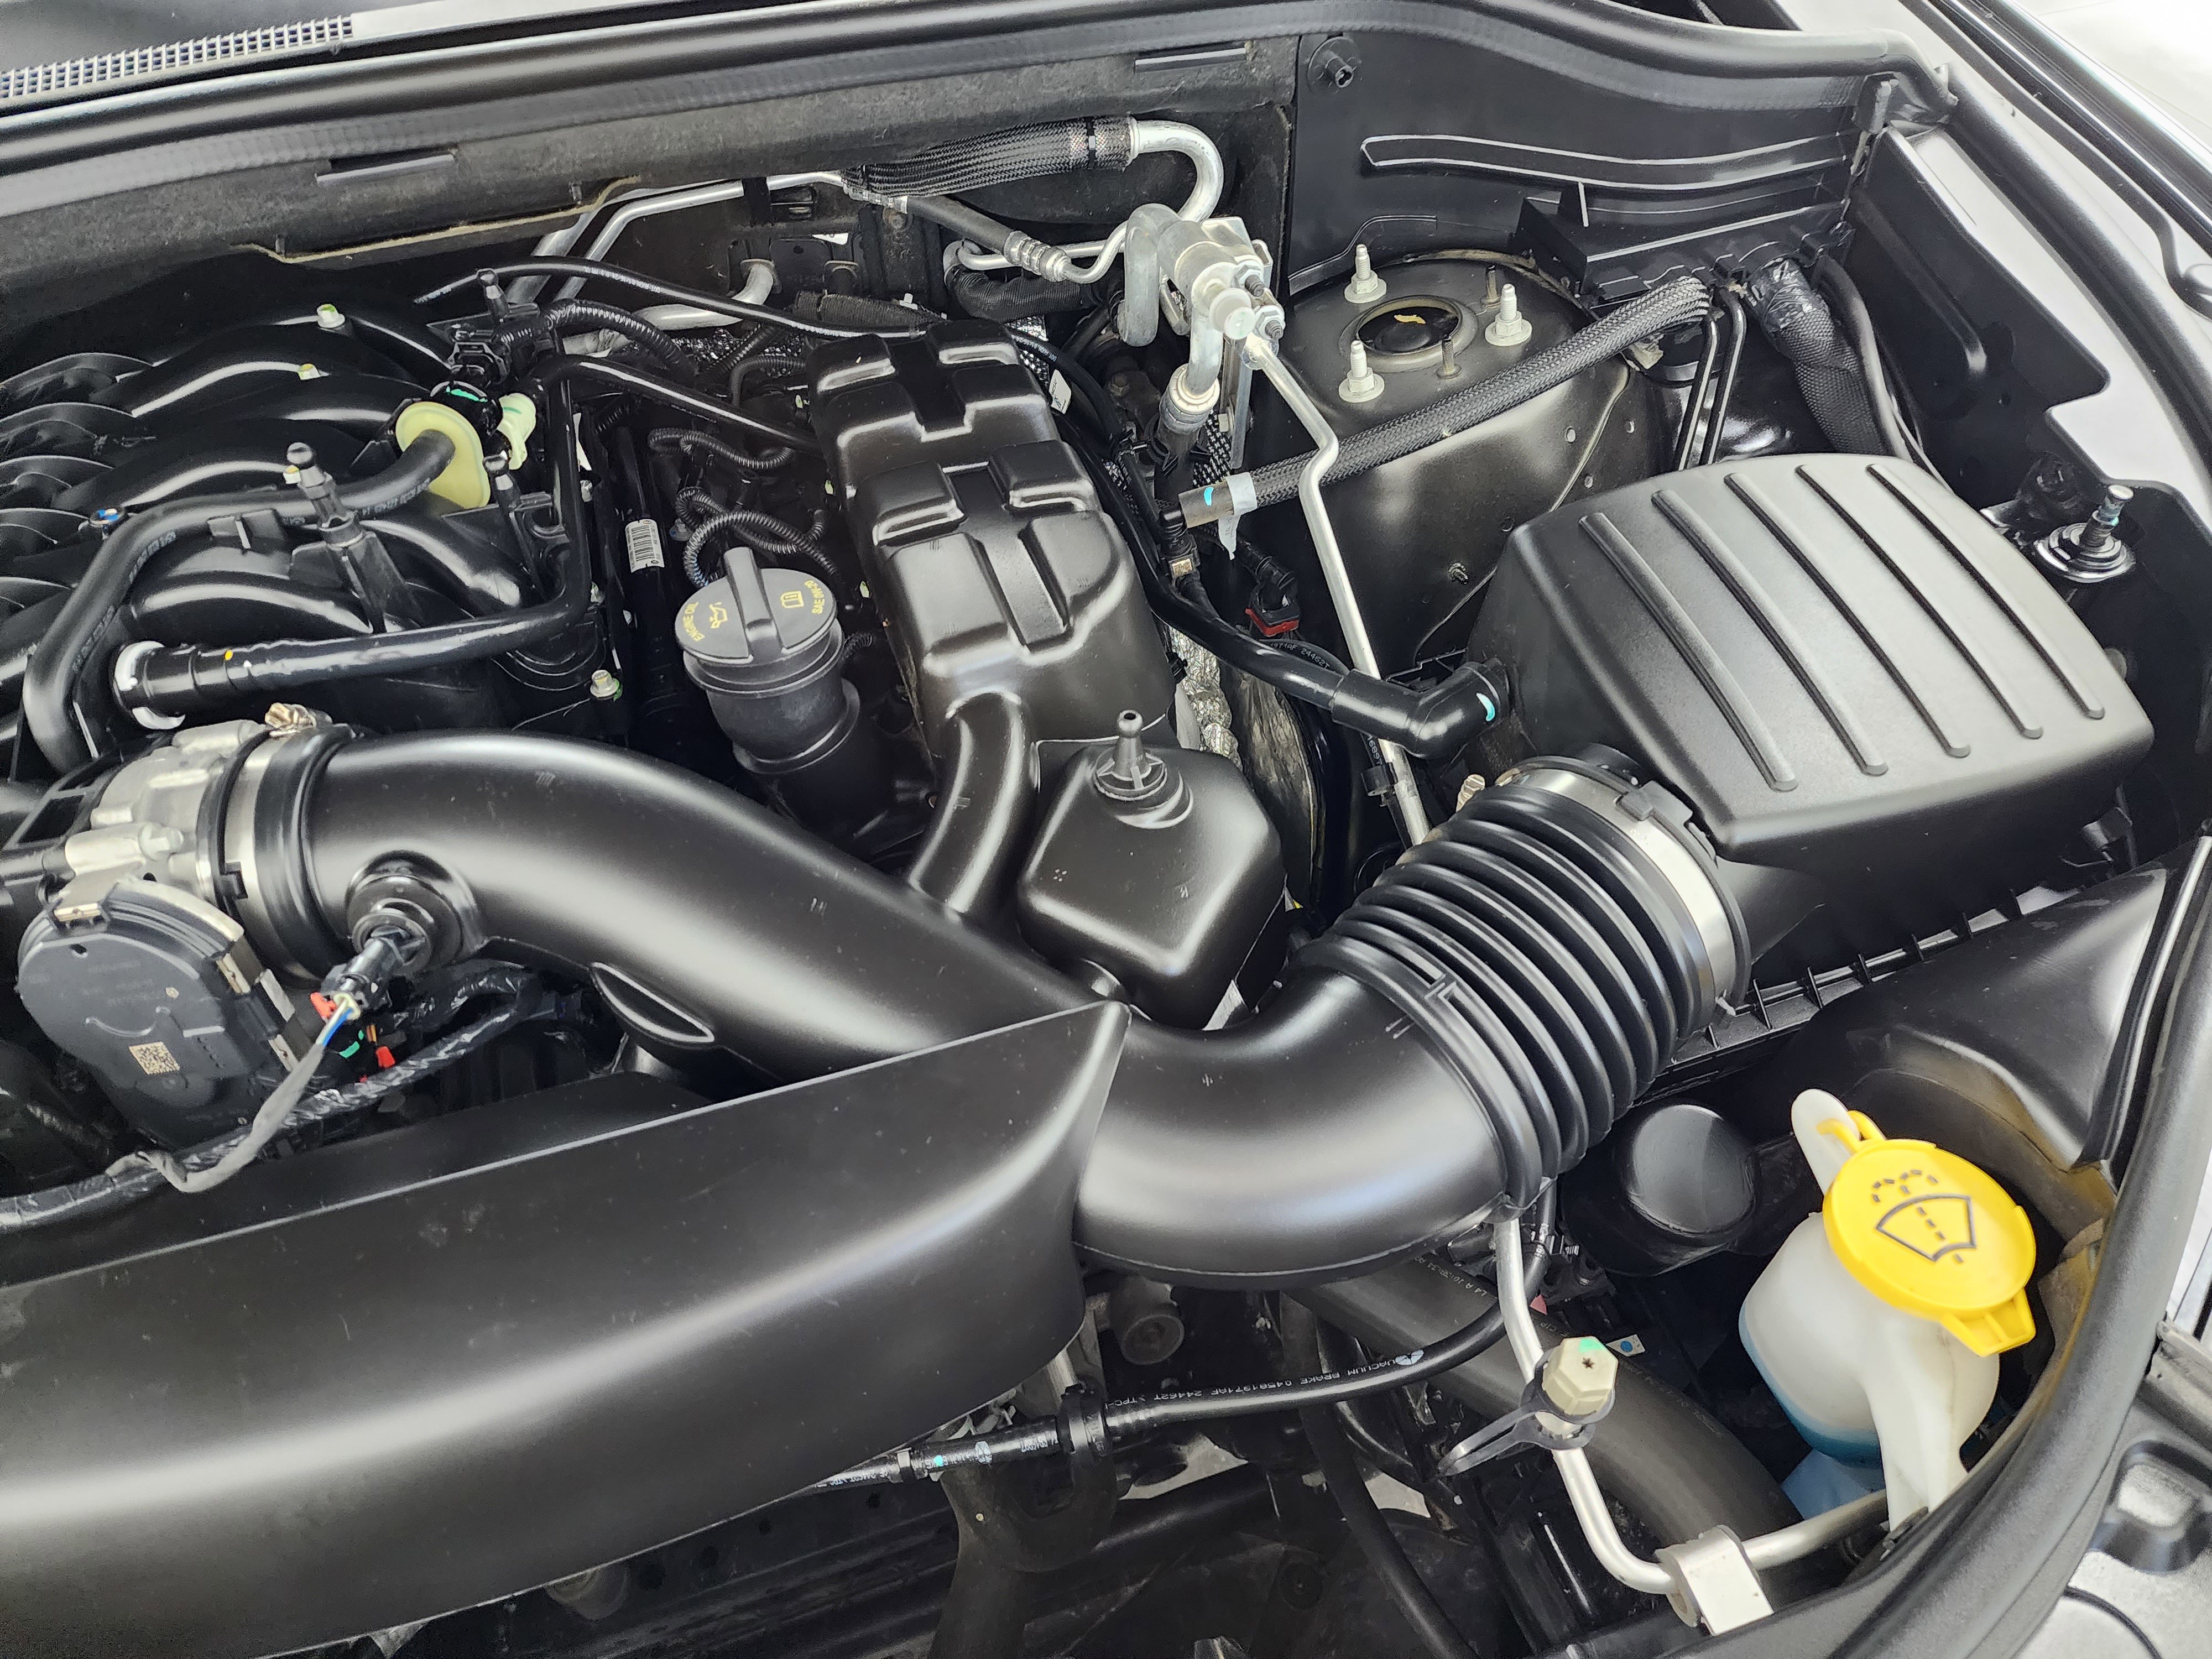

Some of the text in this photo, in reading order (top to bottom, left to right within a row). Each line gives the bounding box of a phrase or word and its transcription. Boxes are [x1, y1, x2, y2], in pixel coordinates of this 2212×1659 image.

[812, 599, 824, 614] SAE
[683, 602, 705, 641] ENGINE OIL
[1301, 648, 1330, 669] 24462T
[1348, 1359, 1395, 1376] VACUUM
[1301, 1371, 1340, 1385] BRAKE
[1154, 1390, 1202, 1400] 24462T
